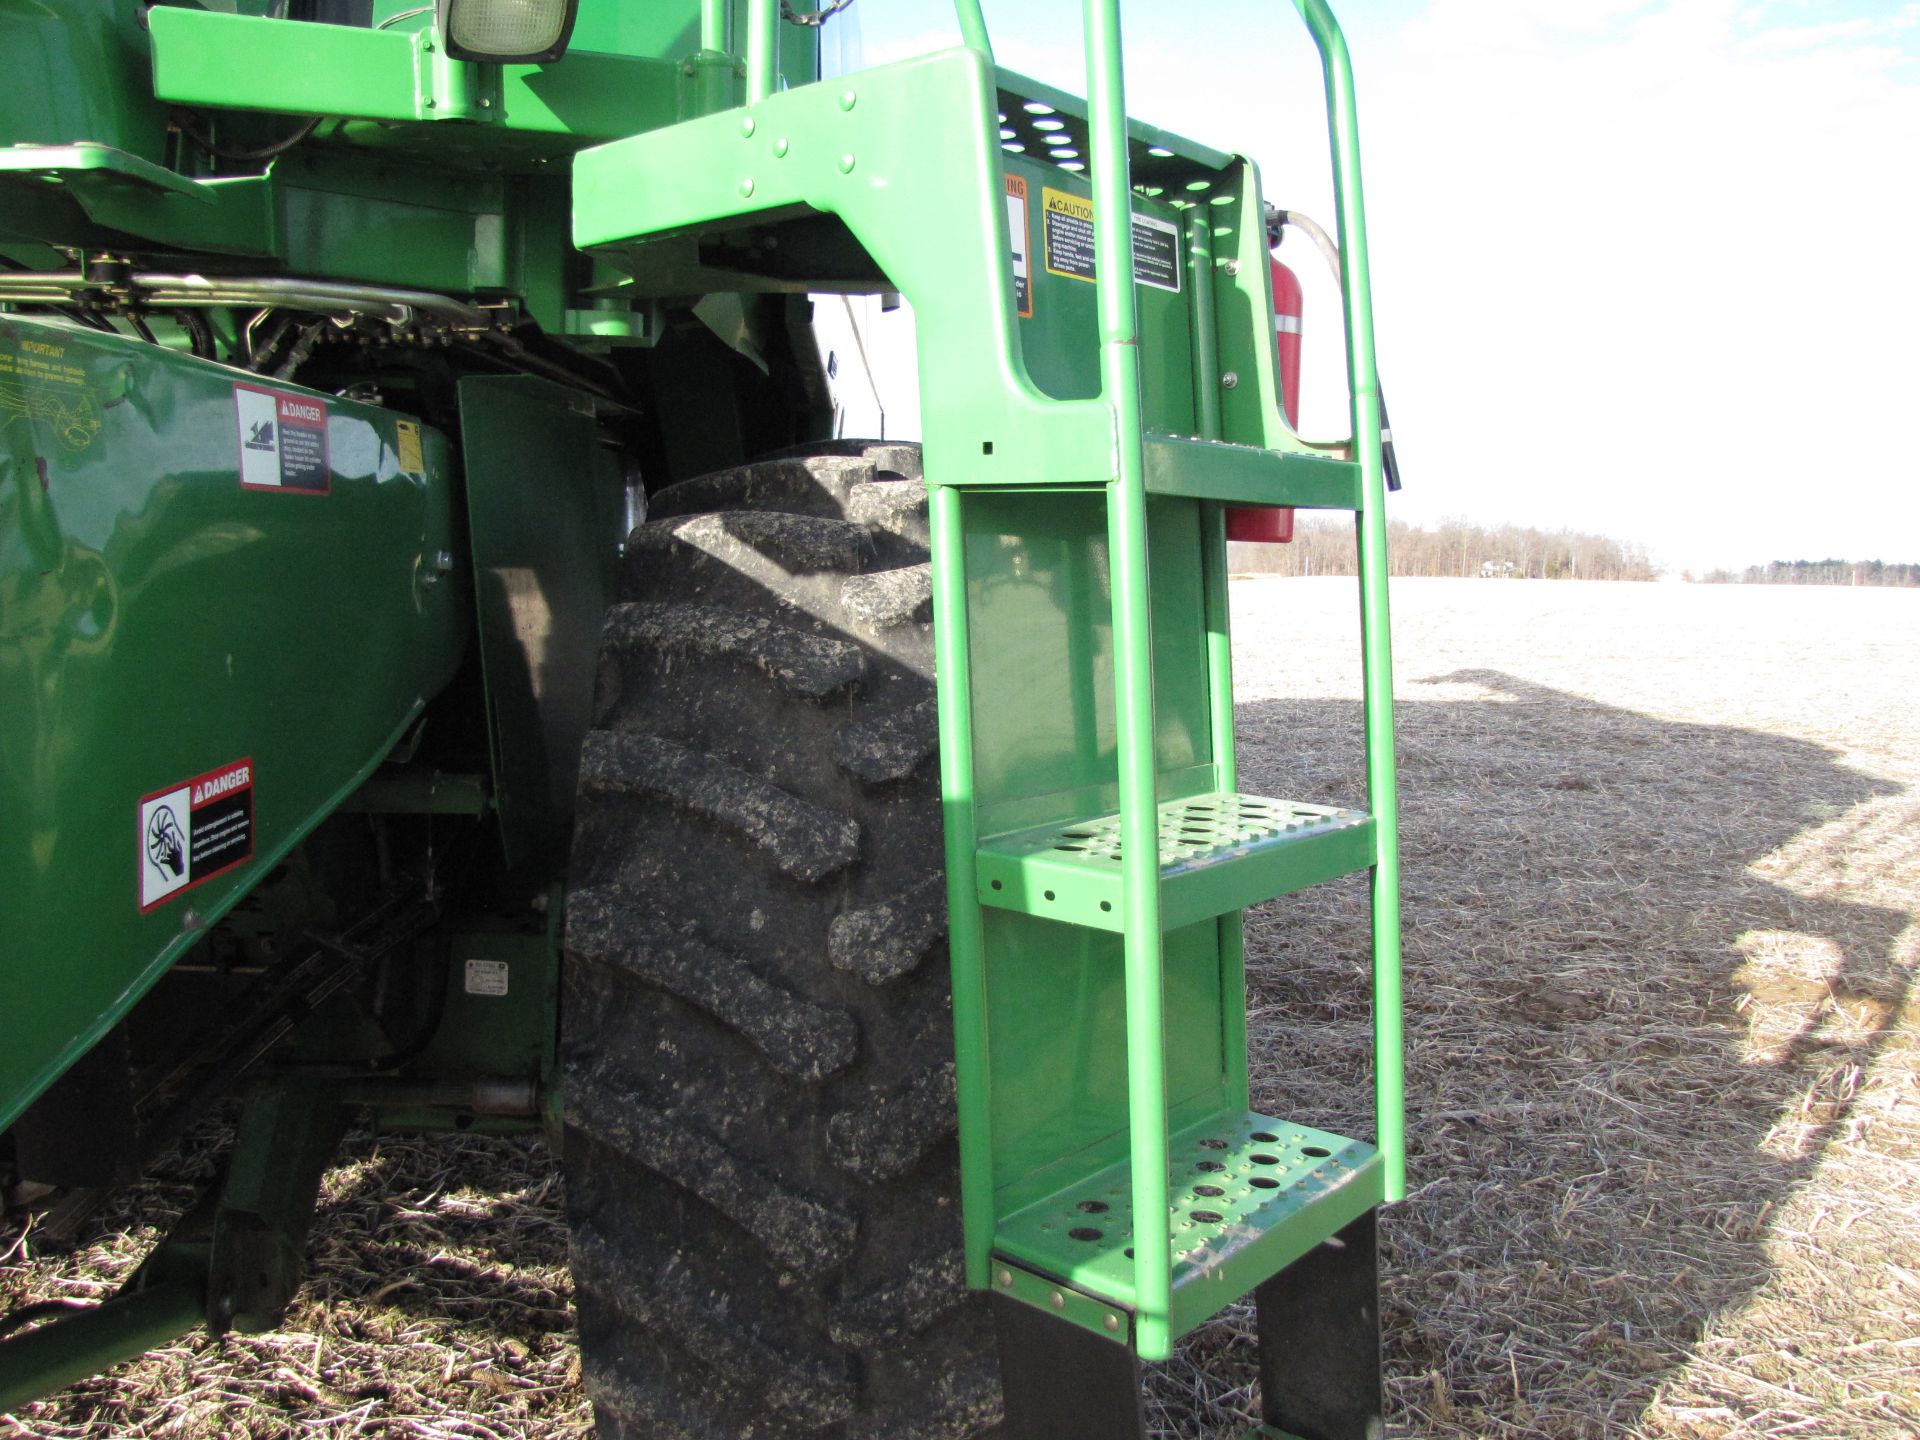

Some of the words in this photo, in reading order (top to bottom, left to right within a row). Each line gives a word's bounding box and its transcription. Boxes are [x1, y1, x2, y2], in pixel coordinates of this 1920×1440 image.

[1007, 178, 1024, 195] ING
[1052, 213, 1061, 221] Keep
[1057, 200, 1094, 219] CAUTION
[1015, 280, 1025, 289] der
[289, 403, 321, 421] DANGER
[204, 766, 250, 800] DANGER
